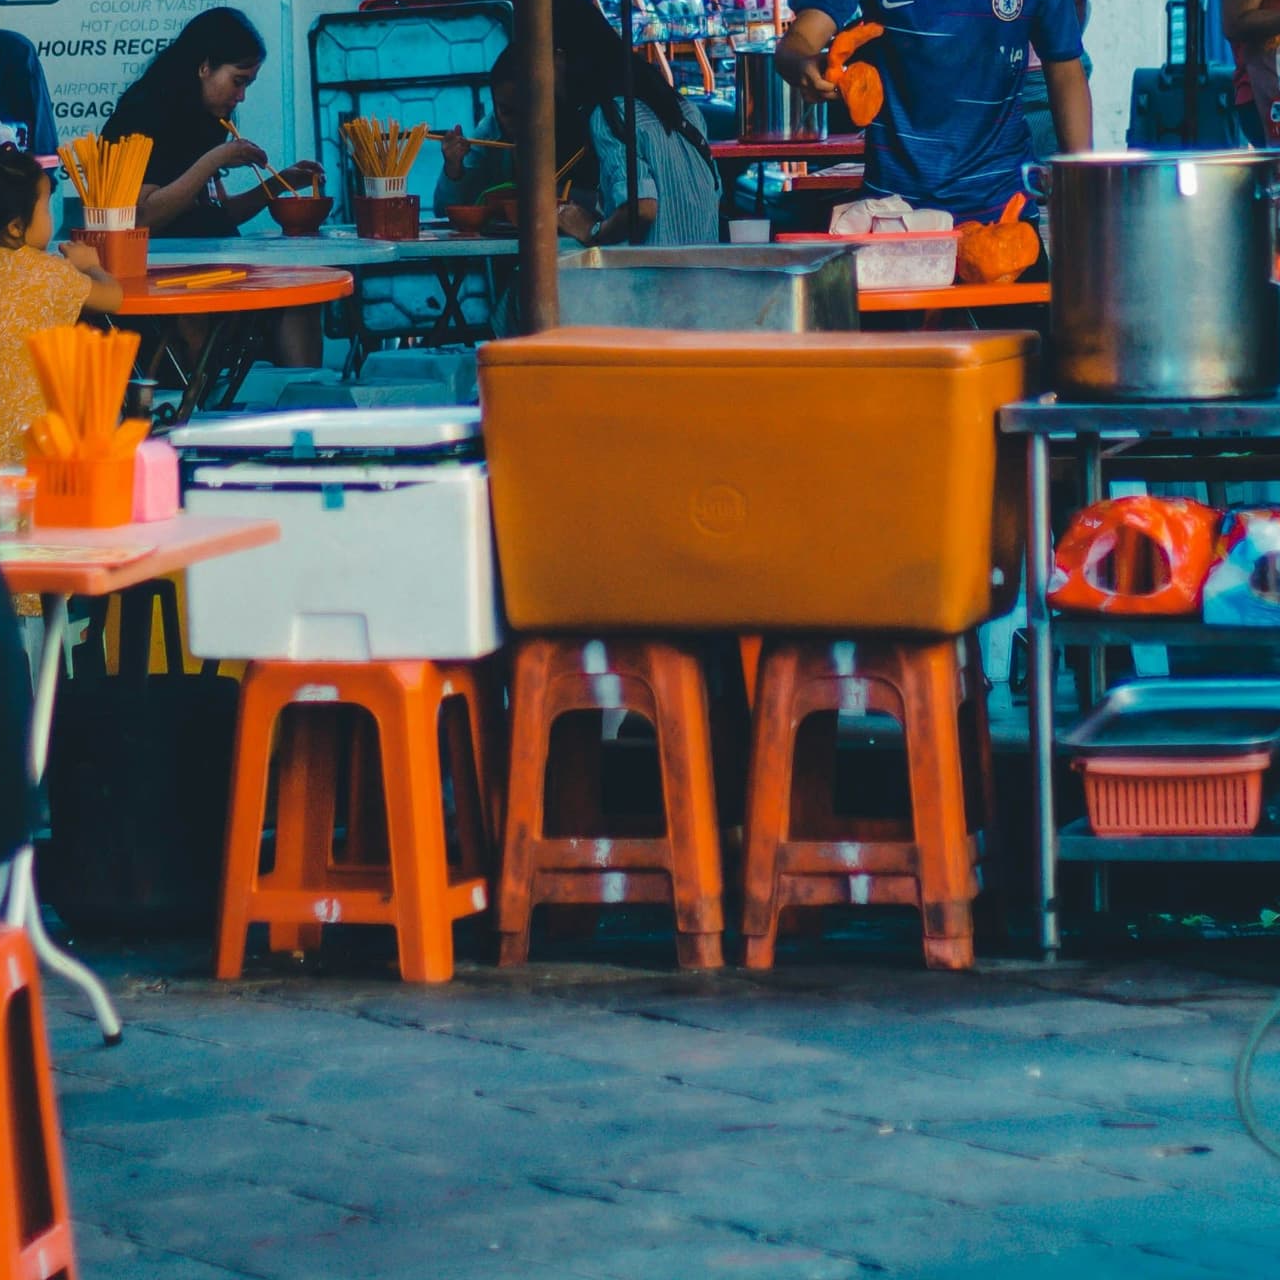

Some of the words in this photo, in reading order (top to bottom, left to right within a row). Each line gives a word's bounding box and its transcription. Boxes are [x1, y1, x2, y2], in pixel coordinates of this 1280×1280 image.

[90, 0, 152, 14] COLOUR
[37, 39, 107, 57] HOURS
[54, 82, 118, 96] AIRPORT
